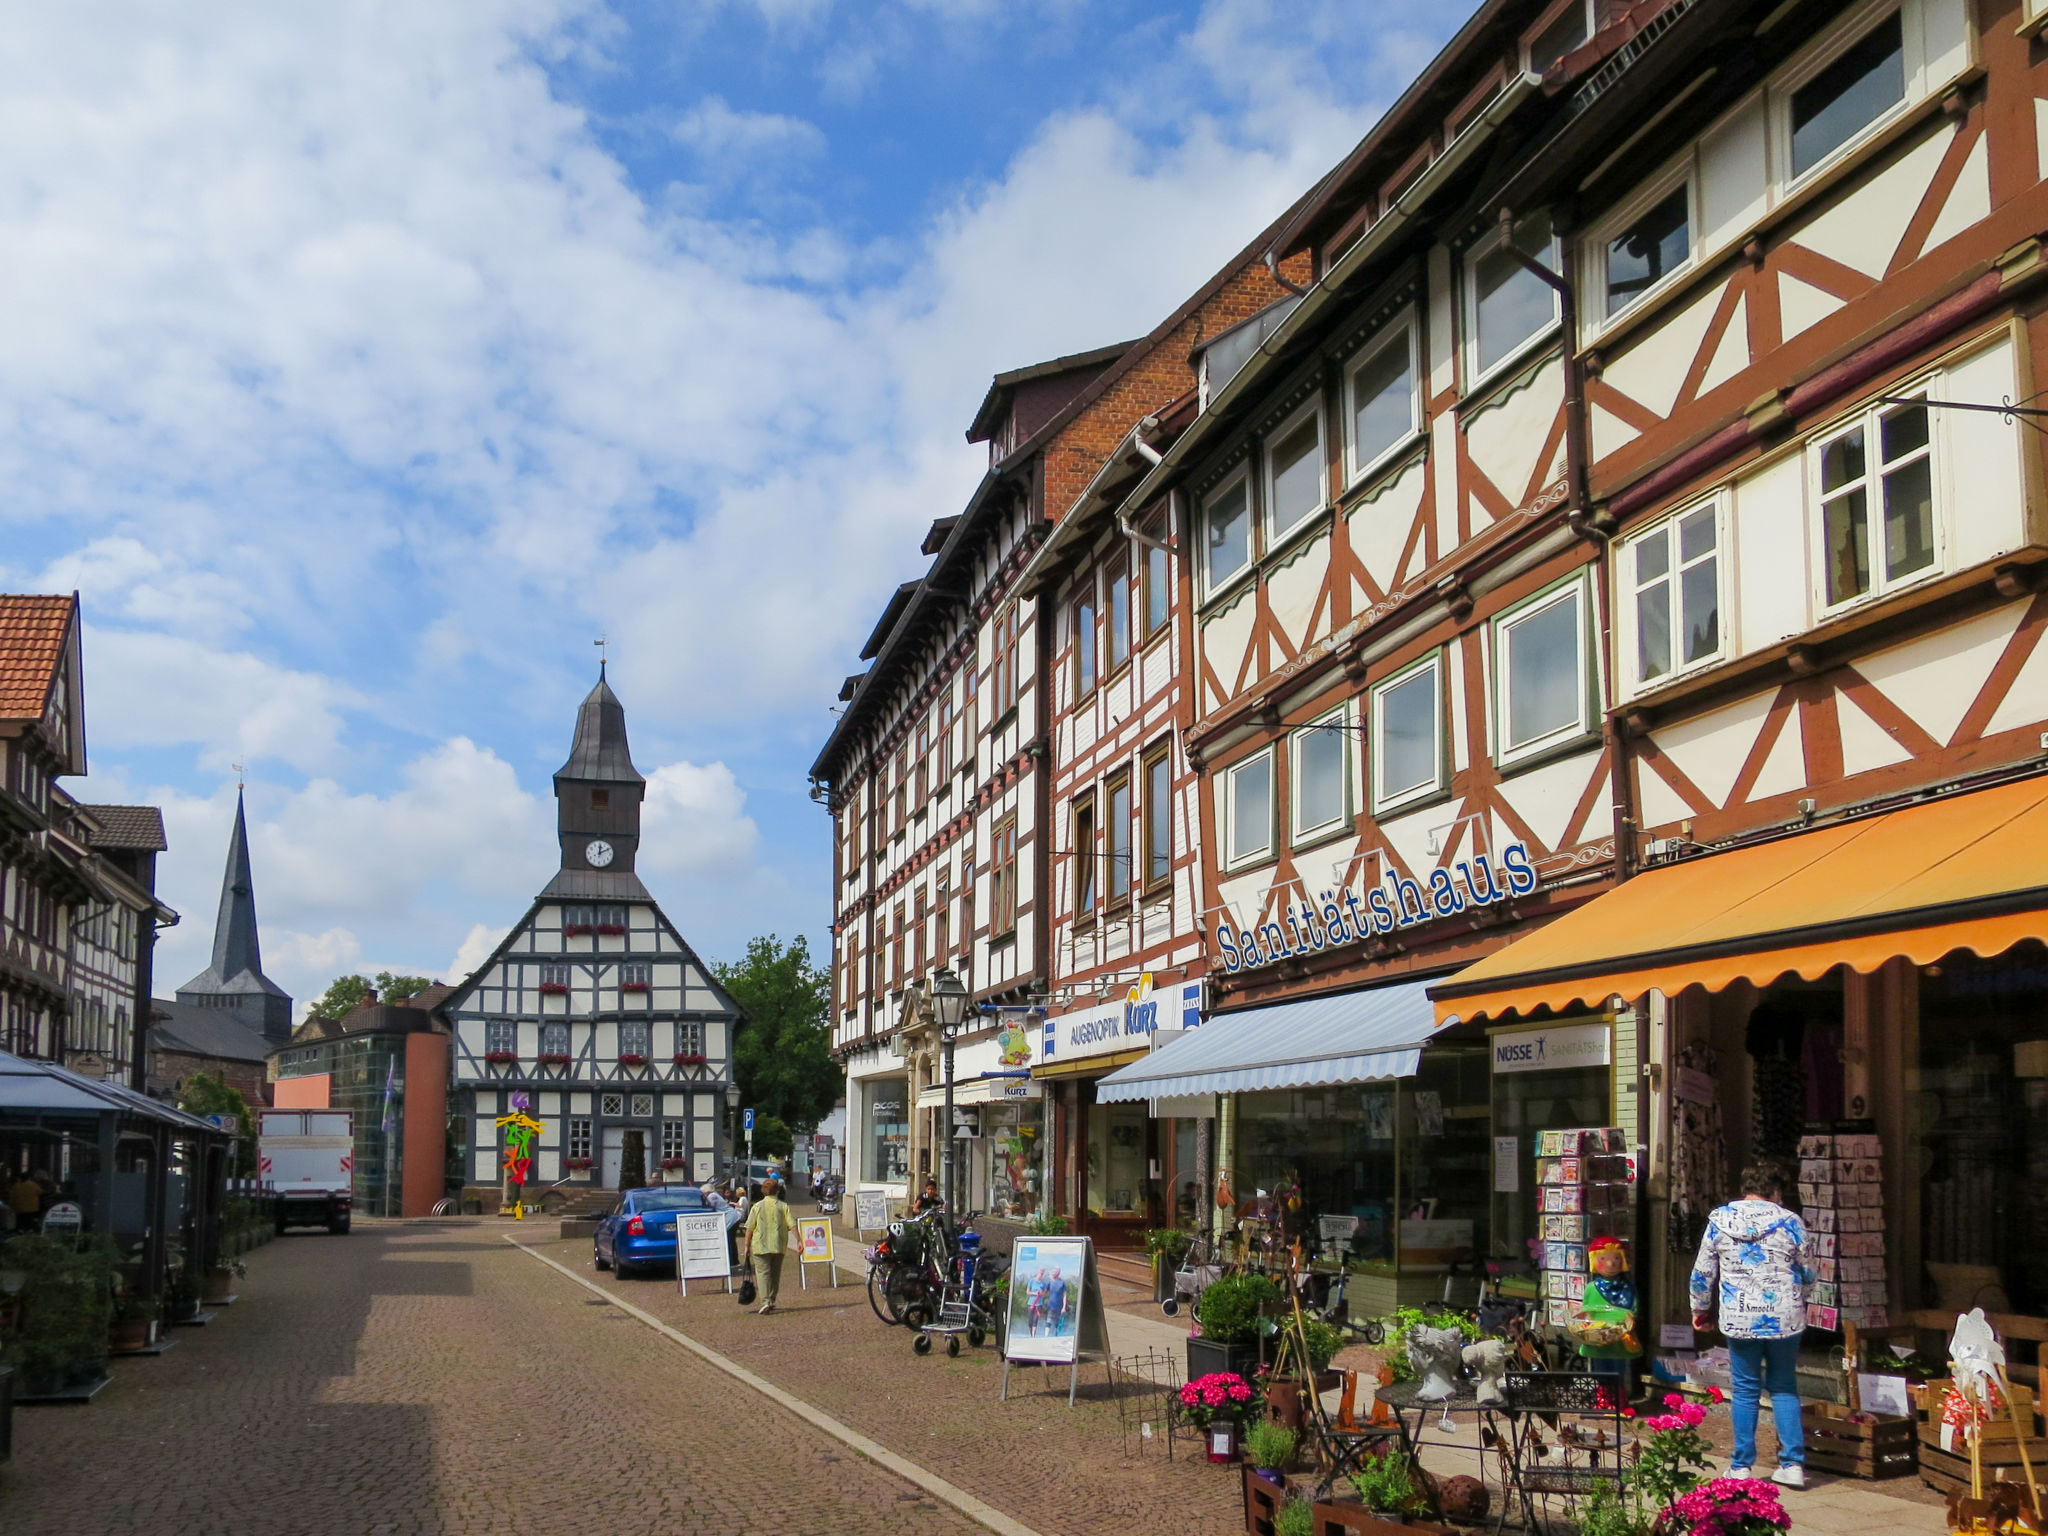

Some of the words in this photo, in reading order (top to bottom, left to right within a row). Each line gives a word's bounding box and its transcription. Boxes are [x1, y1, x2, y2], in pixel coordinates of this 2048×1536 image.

[1217, 842, 1537, 973] Sanitätshaus
[1070, 1016, 1120, 1046] AUGENOPTIK
[1497, 1044, 1532, 1062] NÜSSE
[1852, 1096, 1865, 1116] 9
[686, 1221, 718, 1231] SICHER
[1746, 1302, 1775, 1312] Smooth
